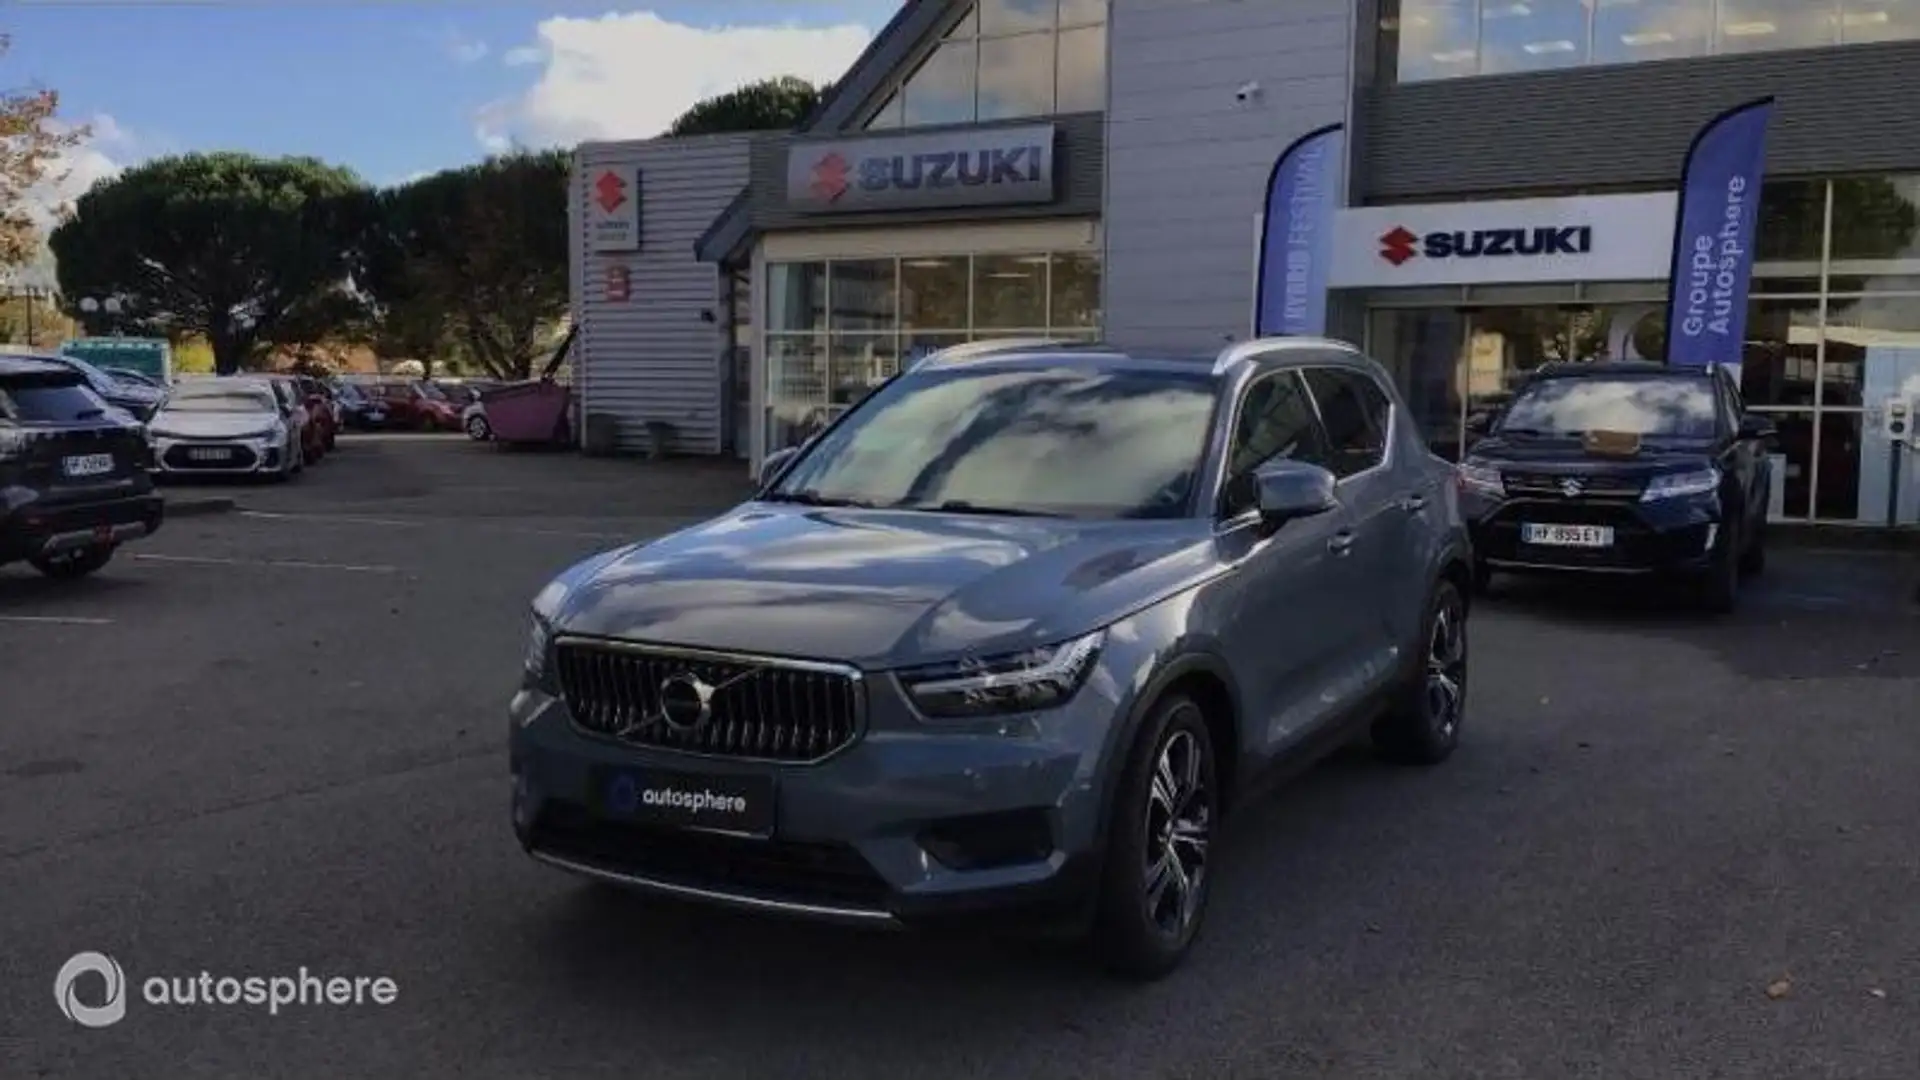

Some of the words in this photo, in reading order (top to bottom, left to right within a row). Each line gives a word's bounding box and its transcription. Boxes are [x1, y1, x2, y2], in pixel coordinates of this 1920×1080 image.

[857, 145, 1042, 190] SUZUKI
[1423, 226, 1591, 258] SUZUKI
[1708, 175, 1746, 335] Autosphere
[1682, 235, 1717, 336] Groupe
[642, 786, 747, 813] autosphere
